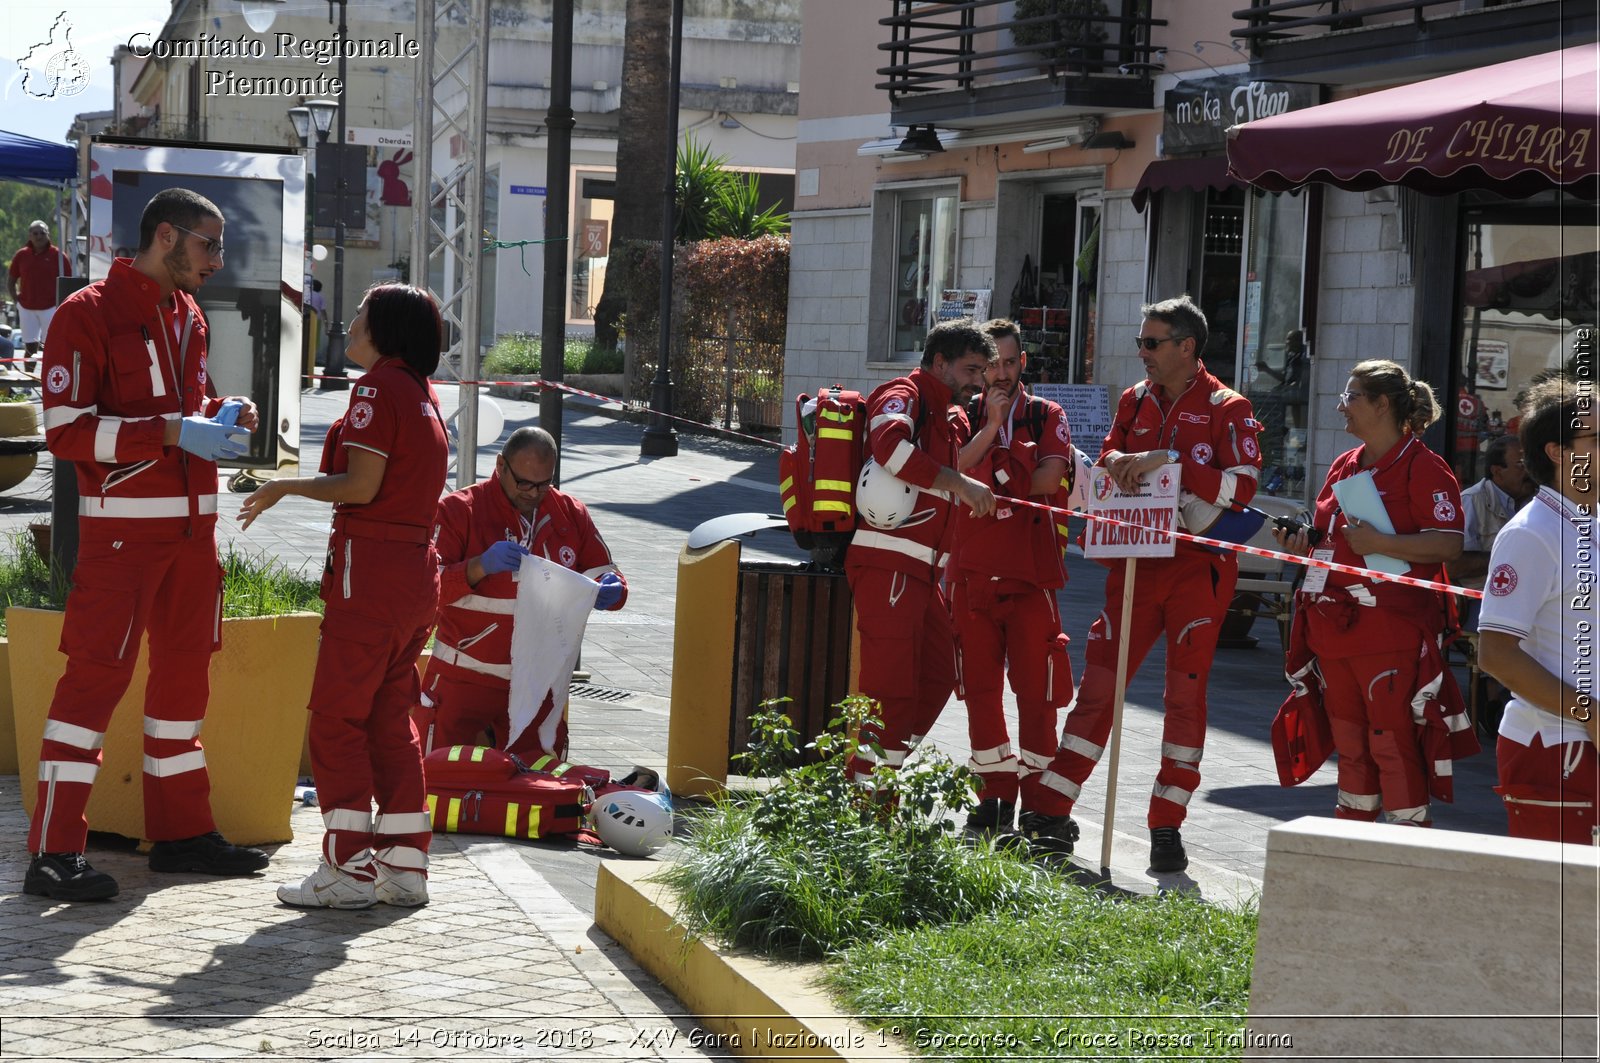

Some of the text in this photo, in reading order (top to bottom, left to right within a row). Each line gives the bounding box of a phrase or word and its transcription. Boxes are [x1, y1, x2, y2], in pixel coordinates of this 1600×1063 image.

[1176, 91, 1221, 124] moka
[378, 137, 411, 145] Oberdan
[1384, 116, 1592, 175] DE CHIARA
[1070, 424, 1082, 432] TTI
[1091, 507, 1173, 546] PIEMONTE
